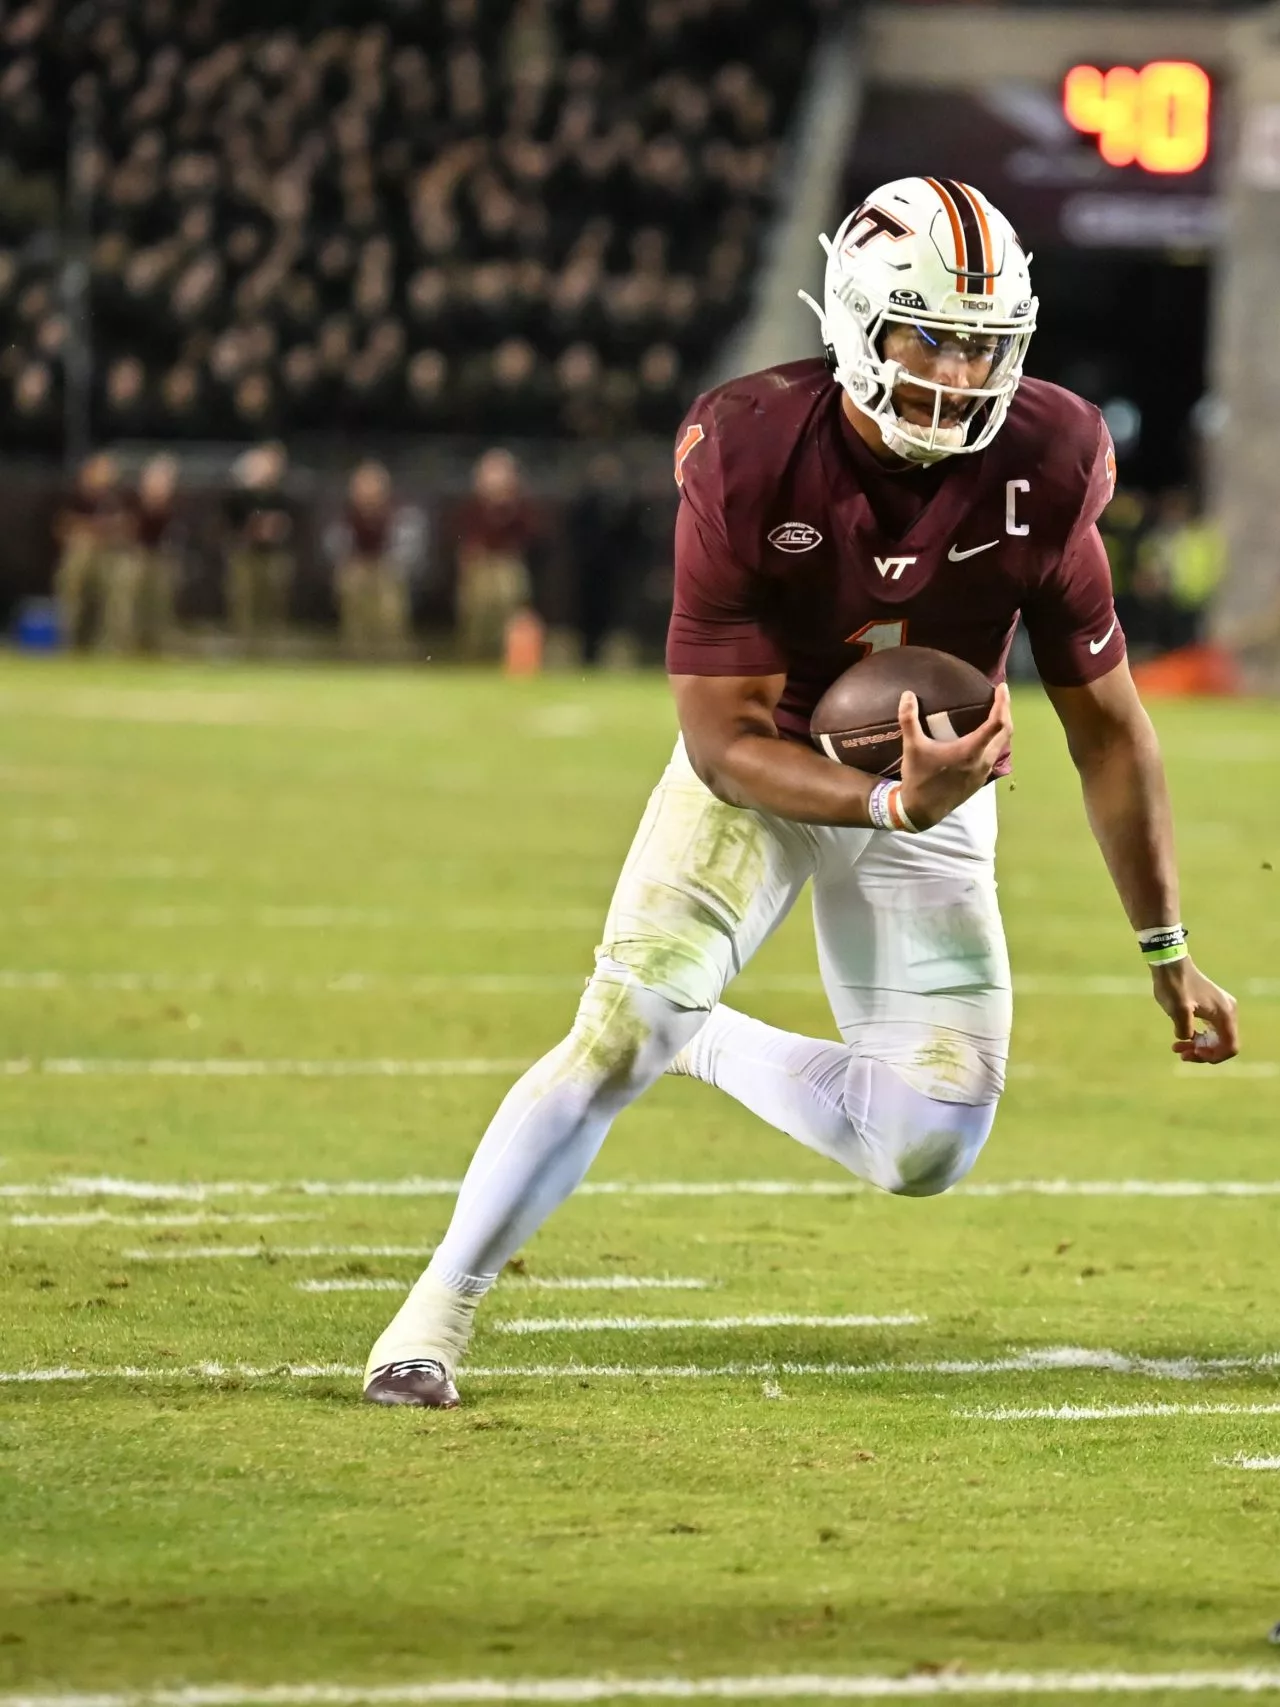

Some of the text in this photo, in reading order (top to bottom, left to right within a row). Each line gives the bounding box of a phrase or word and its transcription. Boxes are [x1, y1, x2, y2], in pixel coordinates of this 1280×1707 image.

[1065, 61, 1209, 172] 40
[960, 300, 994, 311] TECH
[1006, 479, 1030, 536] C
[776, 530, 814, 541] ACC
[873, 556, 917, 580] VT
